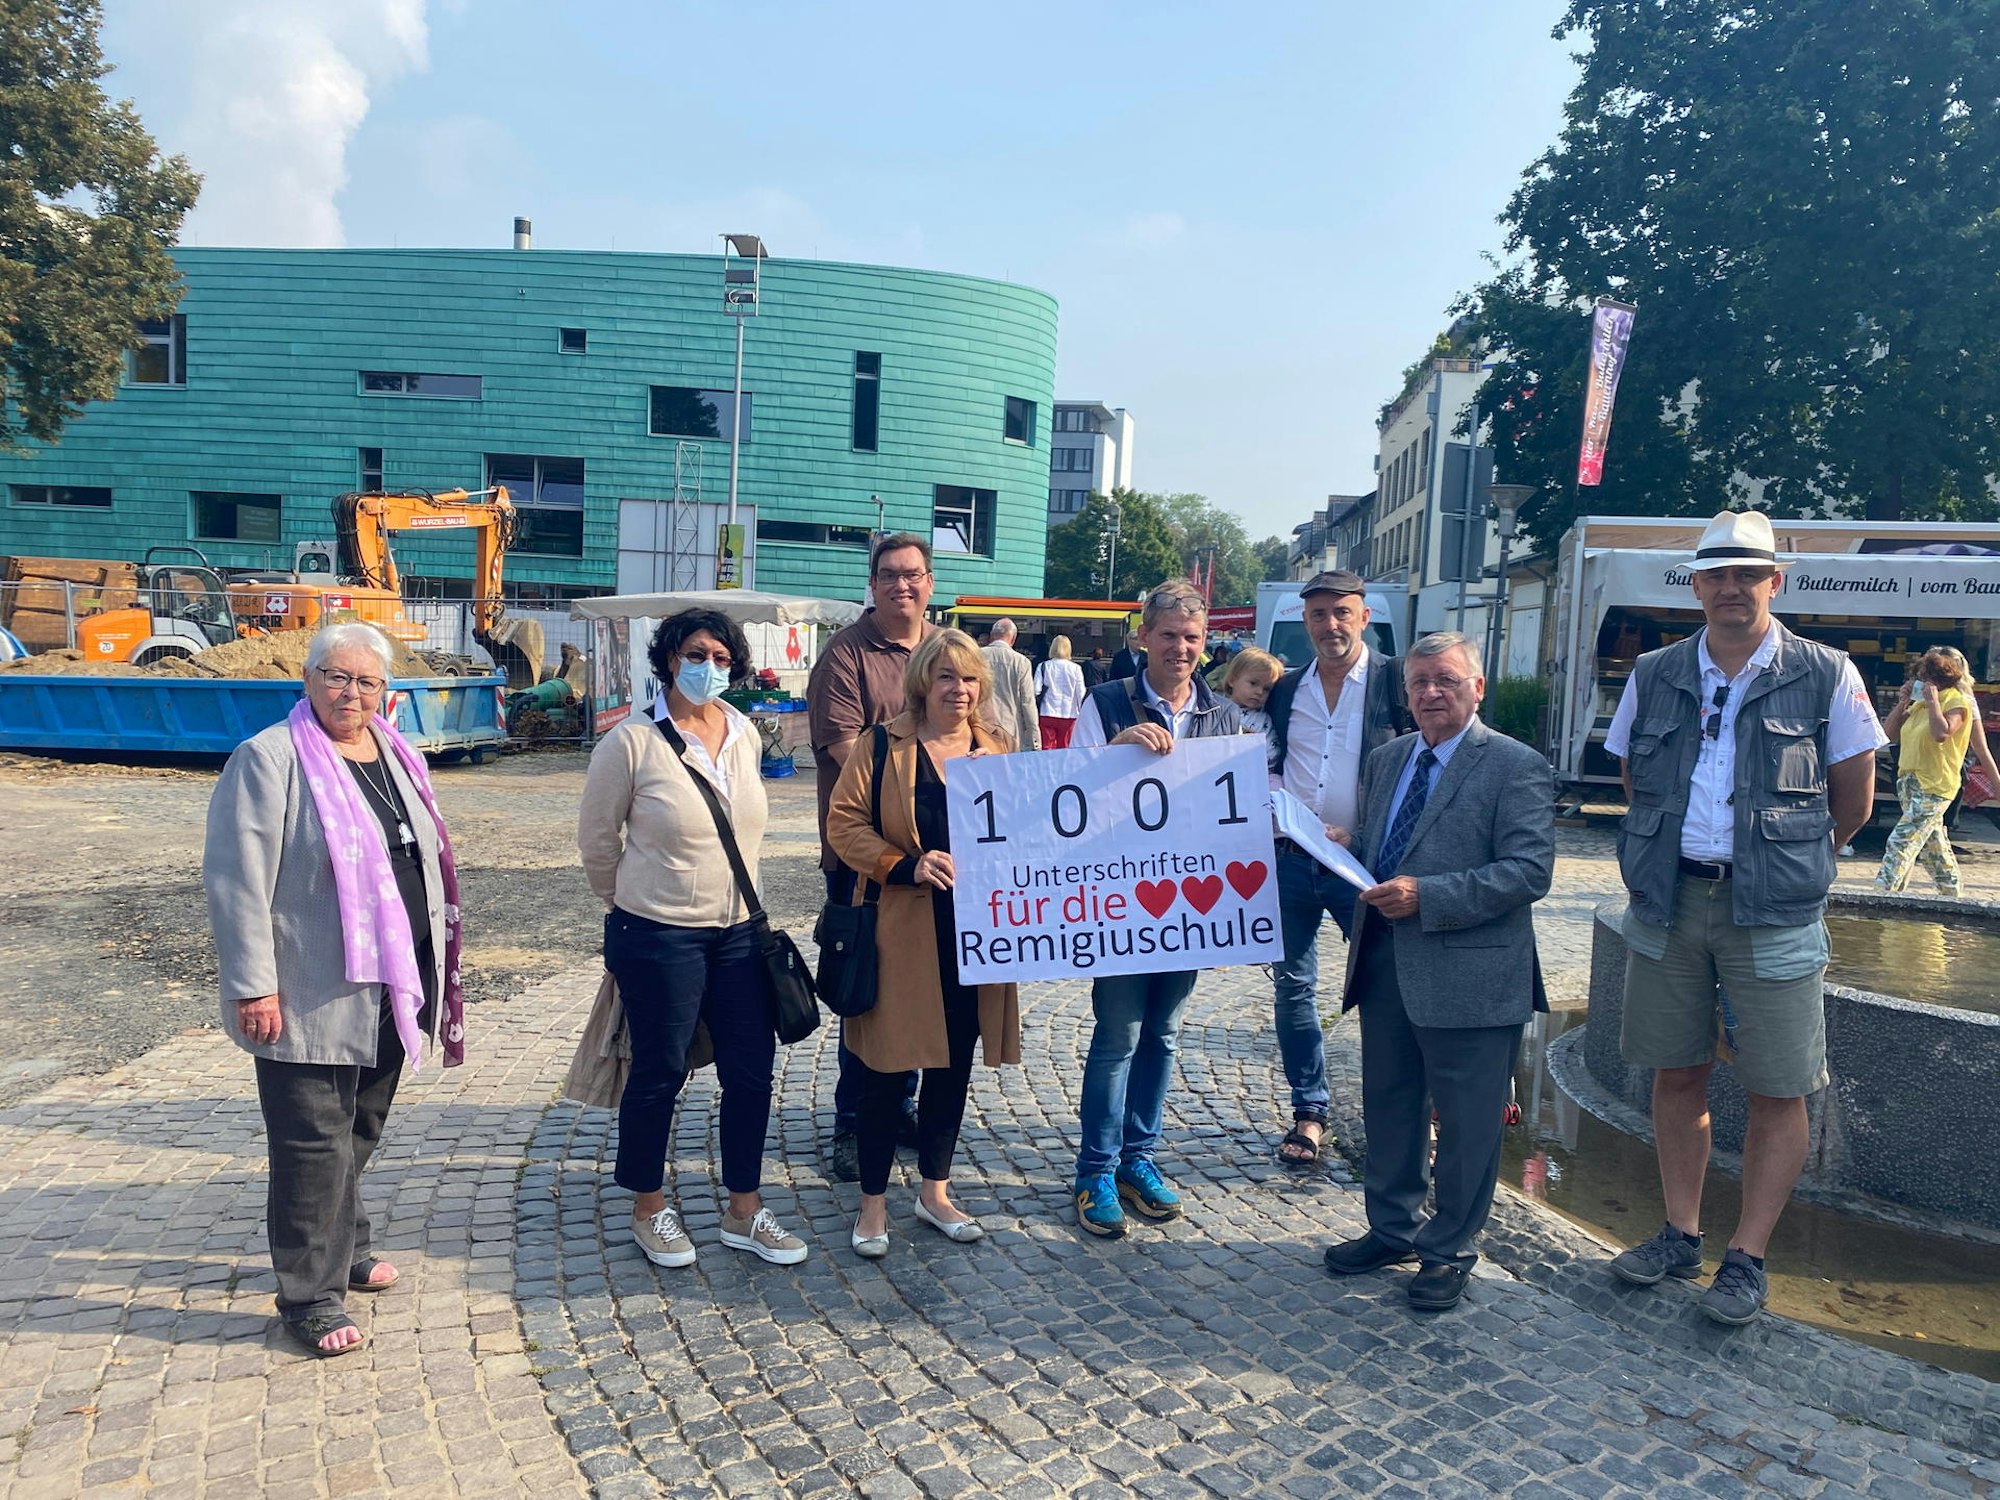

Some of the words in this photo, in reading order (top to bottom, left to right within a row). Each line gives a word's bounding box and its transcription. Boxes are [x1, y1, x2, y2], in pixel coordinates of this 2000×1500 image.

[1796, 575, 1900, 593] Buttermilch
[1920, 581, 1958, 594] vom
[1963, 577, 2000, 594] Bau
[1013, 852, 1216, 888] Unterschriften
[988, 890, 1050, 928] für
[1063, 885, 1127, 923] die
[960, 908, 1275, 968] Remigiuschule
